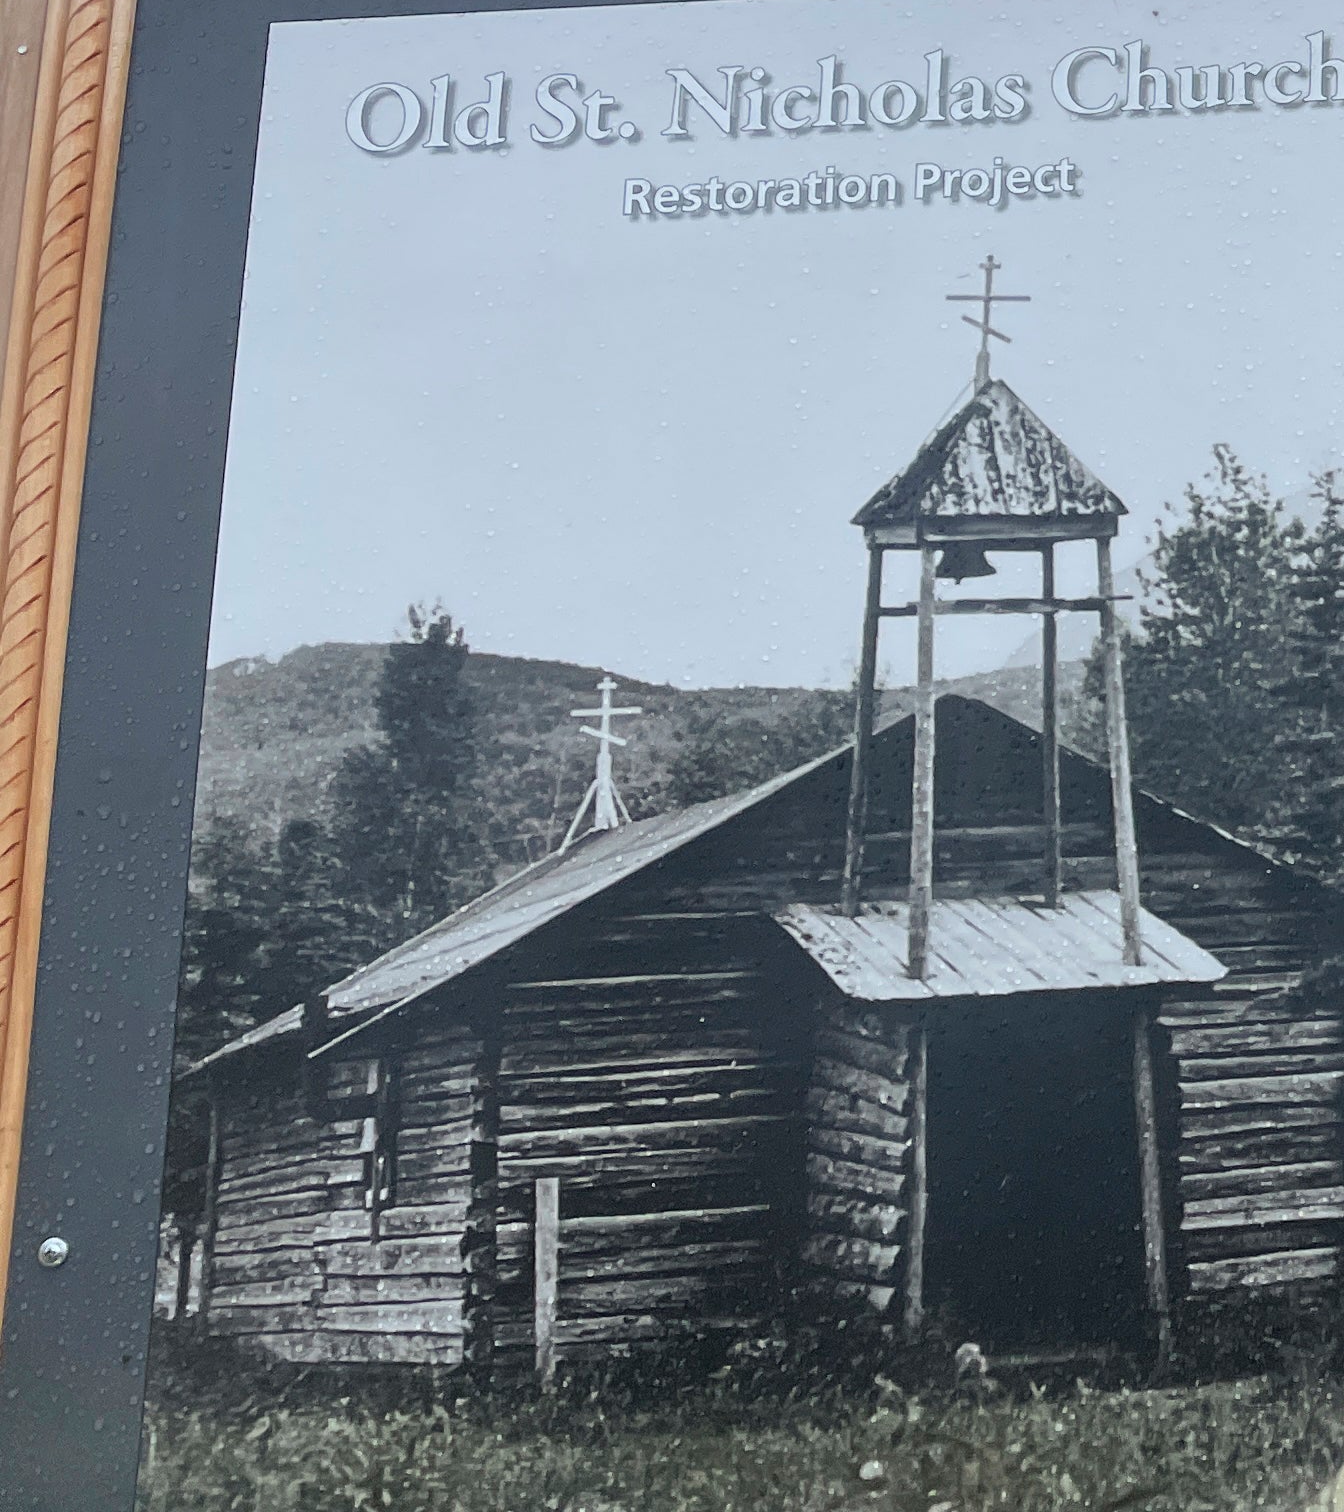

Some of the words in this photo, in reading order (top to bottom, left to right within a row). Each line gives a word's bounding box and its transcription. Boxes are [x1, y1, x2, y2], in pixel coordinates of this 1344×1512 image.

[344, 70, 507, 153] Old
[529, 71, 638, 145] St.
[659, 48, 1027, 138] Nicholas
[621, 165, 898, 217] Restoration
[913, 156, 1077, 207] Project
